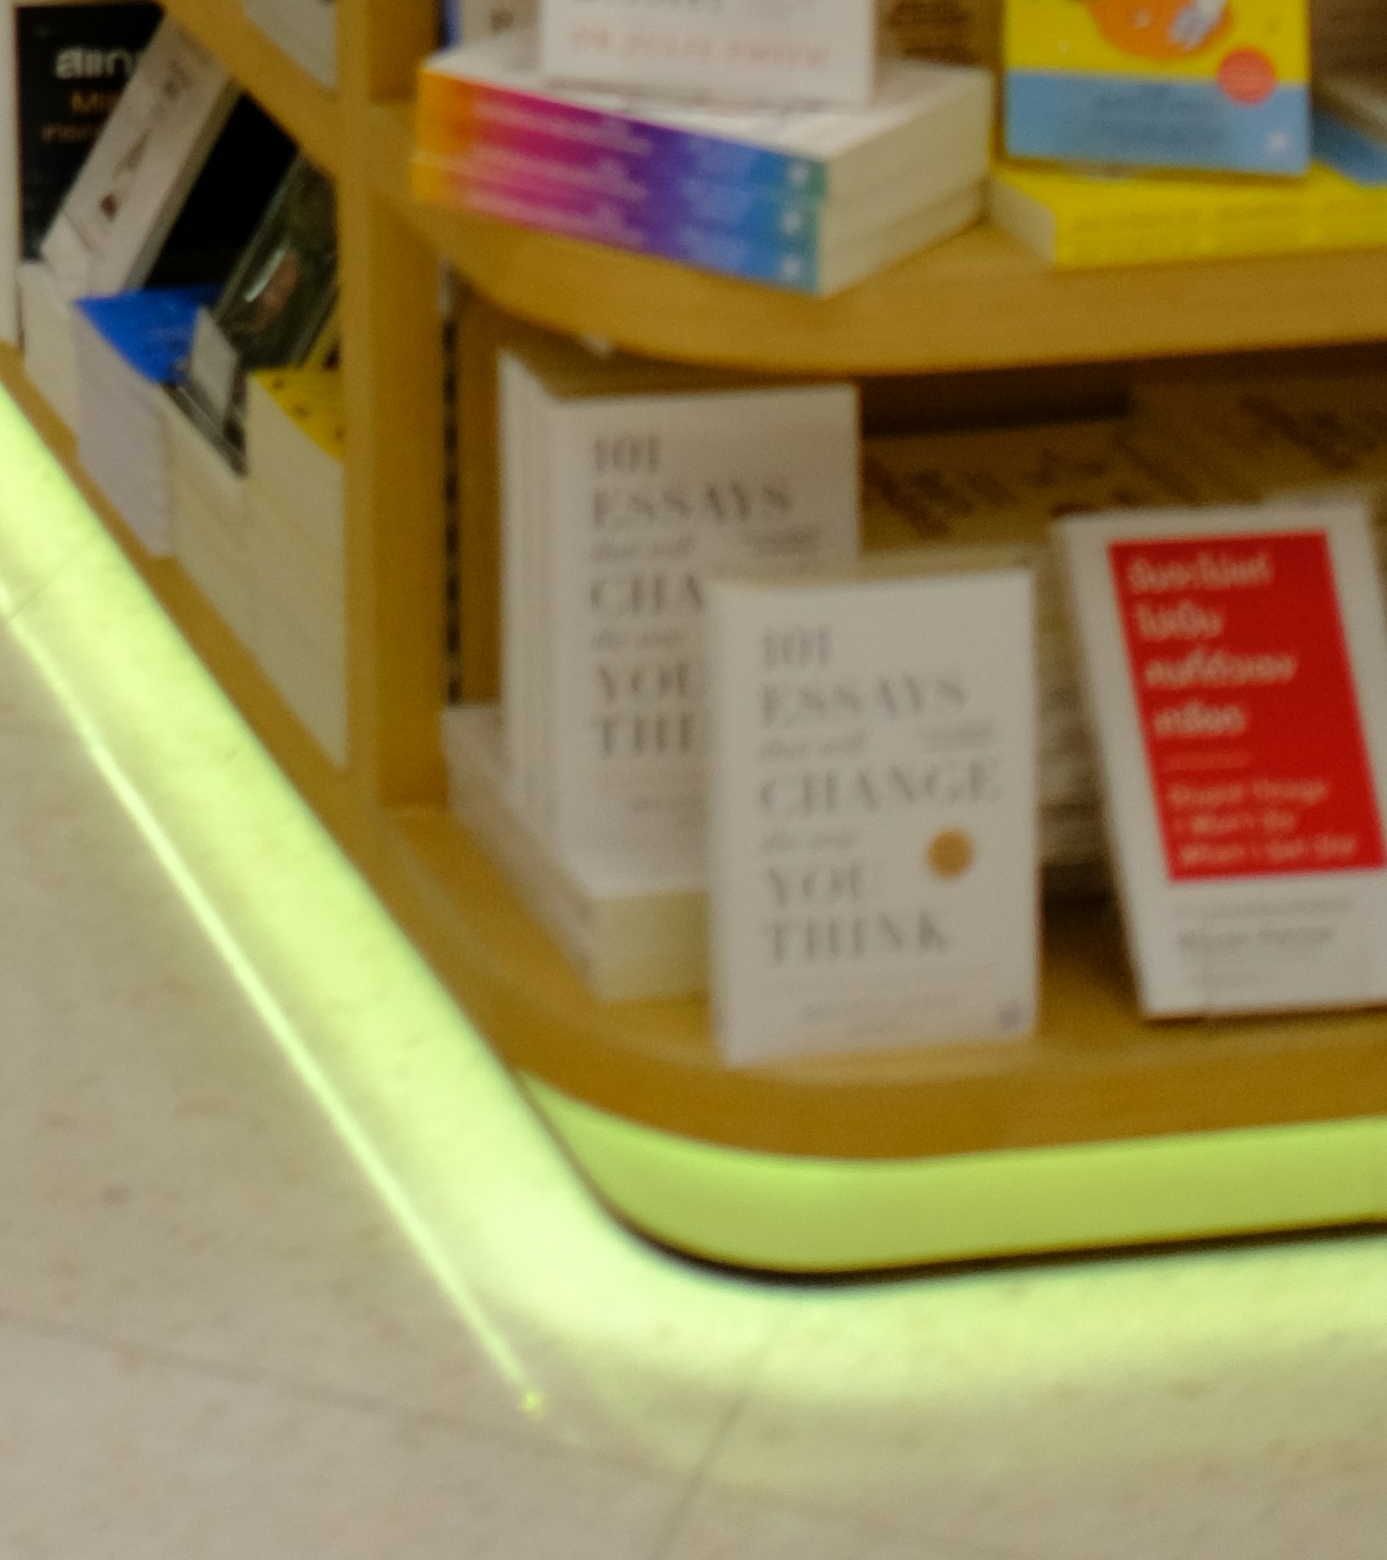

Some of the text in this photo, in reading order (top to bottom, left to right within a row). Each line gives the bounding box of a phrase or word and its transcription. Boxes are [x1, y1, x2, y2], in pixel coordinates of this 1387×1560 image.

[593, 434, 661, 474] 101
[592, 478, 795, 530] ESSAYS
[591, 572, 706, 618] CHA
[759, 626, 831, 670] 101
[759, 673, 968, 725] ESSAYS
[598, 710, 694, 760] THI
[758, 760, 1004, 817] CHANGE
[766, 863, 864, 910] YOU
[764, 912, 951, 968] THINK
